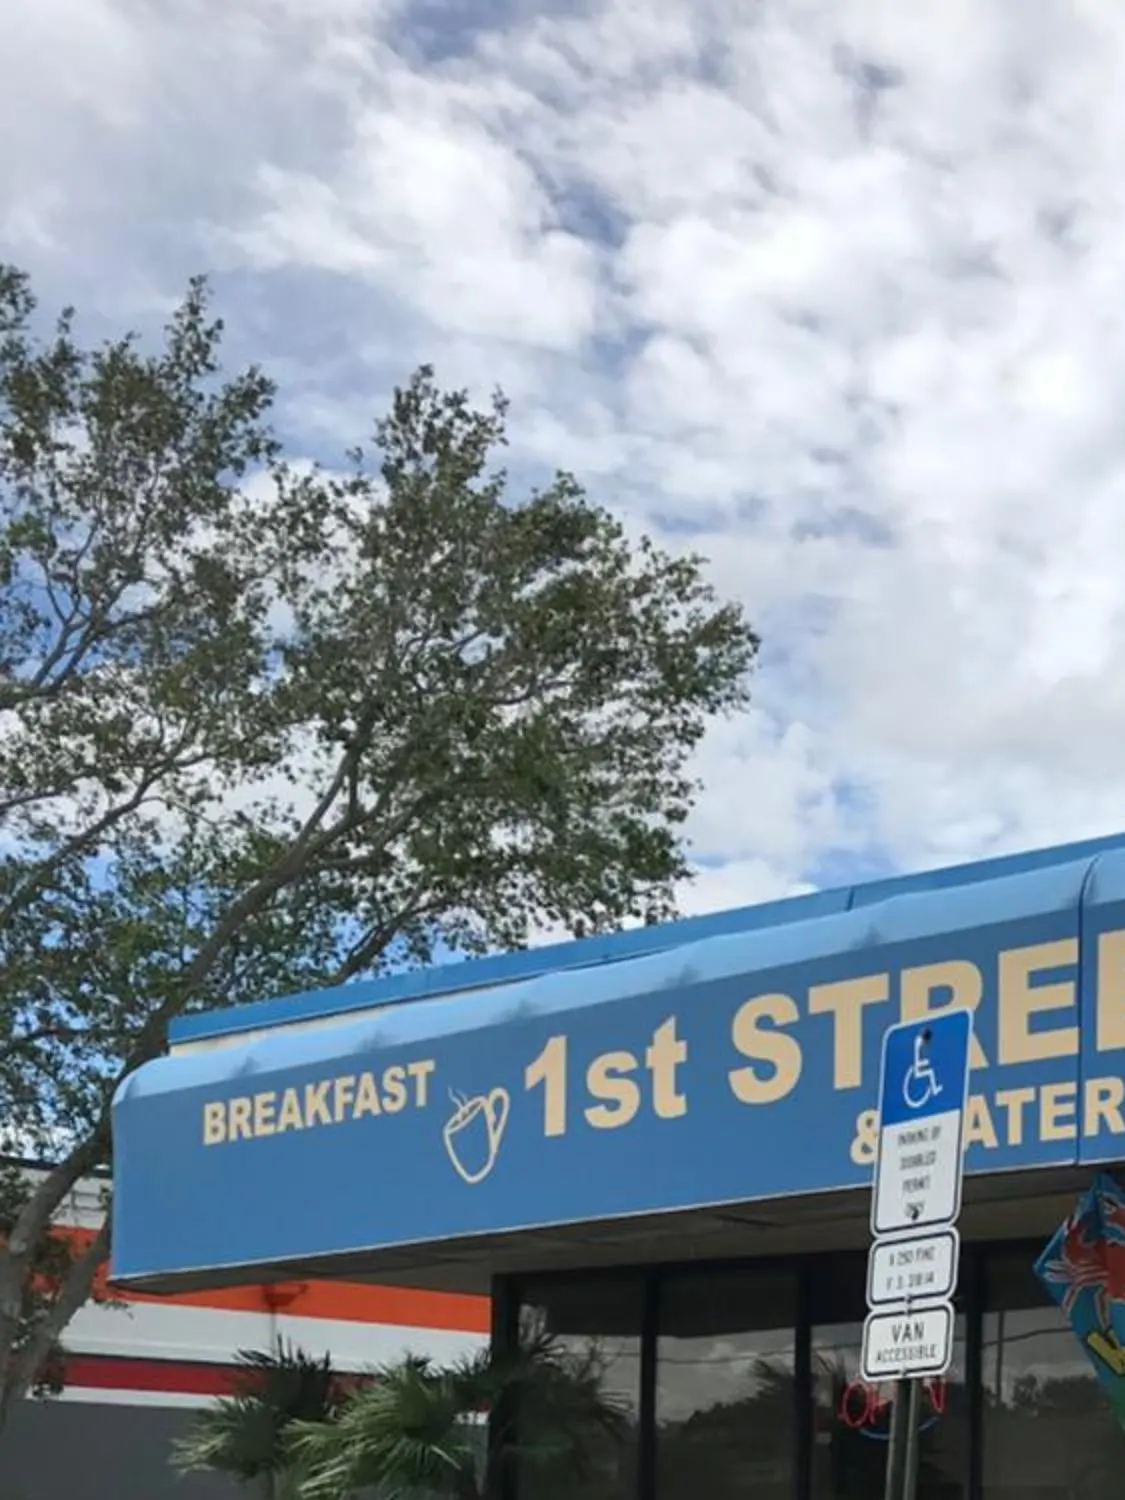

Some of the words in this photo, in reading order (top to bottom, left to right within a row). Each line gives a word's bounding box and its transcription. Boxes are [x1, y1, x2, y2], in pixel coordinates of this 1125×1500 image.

[203, 1060, 436, 1144] BREAKFAST
[526, 1017, 687, 1137] 1st
[875, 1343, 938, 1364] ACCESSIBLE
[890, 1320, 926, 1346] VAN
